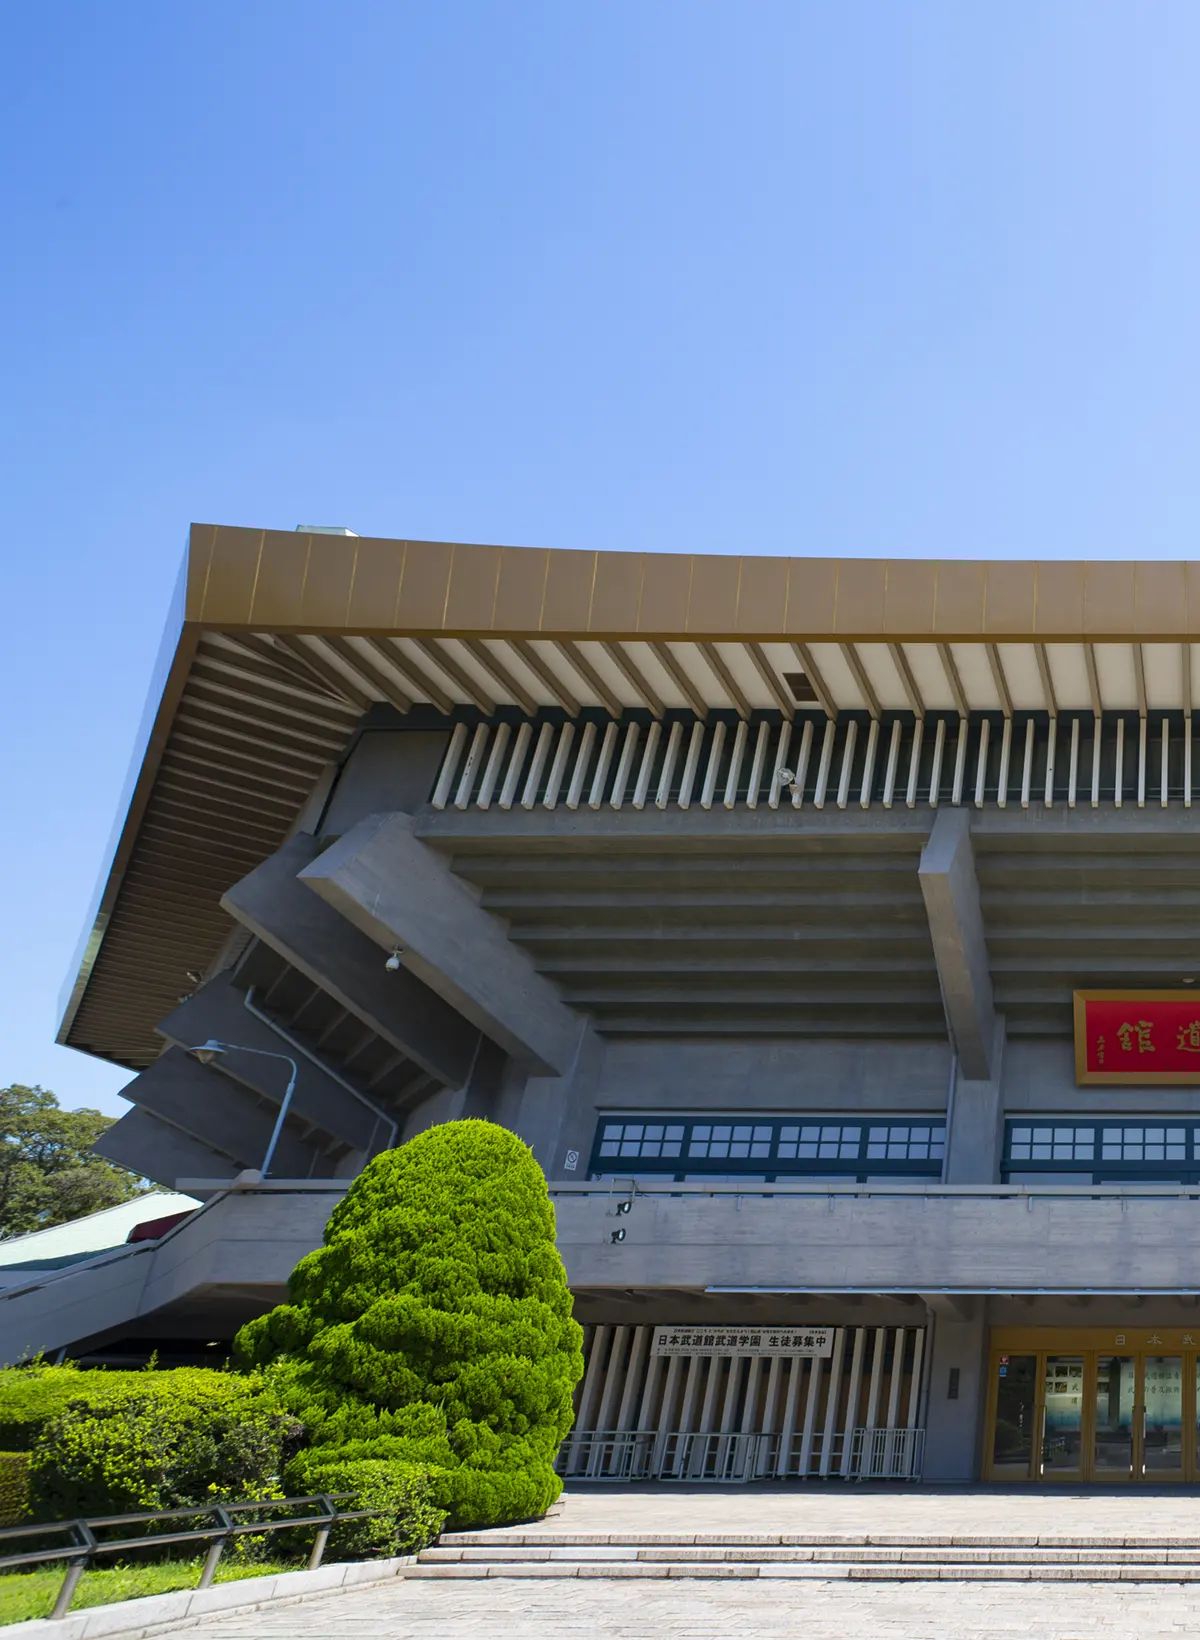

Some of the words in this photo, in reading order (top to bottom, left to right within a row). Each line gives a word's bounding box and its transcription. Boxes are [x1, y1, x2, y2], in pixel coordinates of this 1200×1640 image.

[658, 1334, 762, 1347] 日本武道館武道学園
[768, 1335, 826, 1348] 生徒募集中
